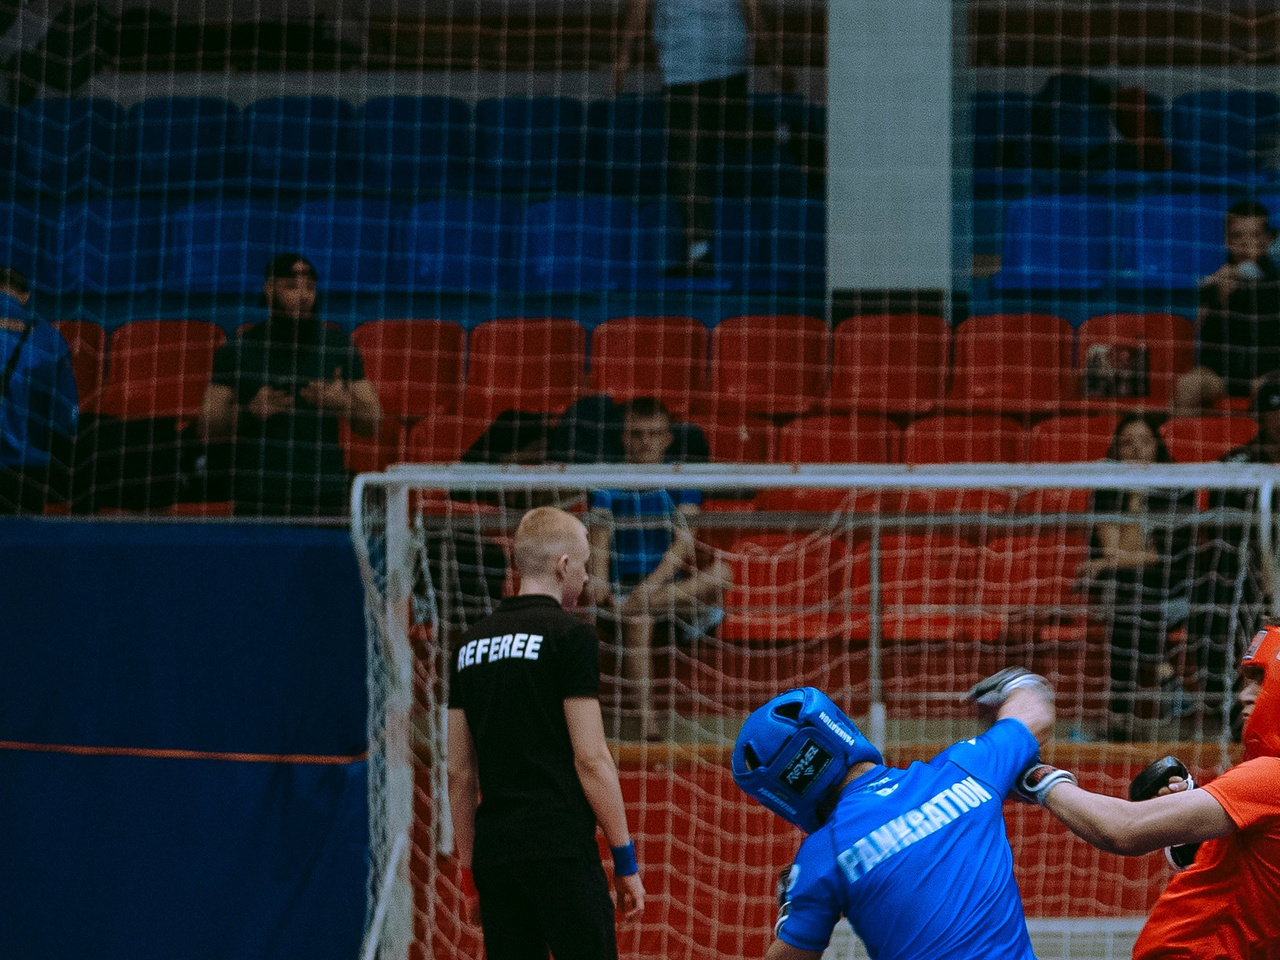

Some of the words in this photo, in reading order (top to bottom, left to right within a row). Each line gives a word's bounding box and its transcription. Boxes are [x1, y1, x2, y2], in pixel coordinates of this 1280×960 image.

[457, 633, 544, 672] REFEREE
[818, 711, 856, 747] PANKRATION
[837, 776, 993, 883] PANKRATION
